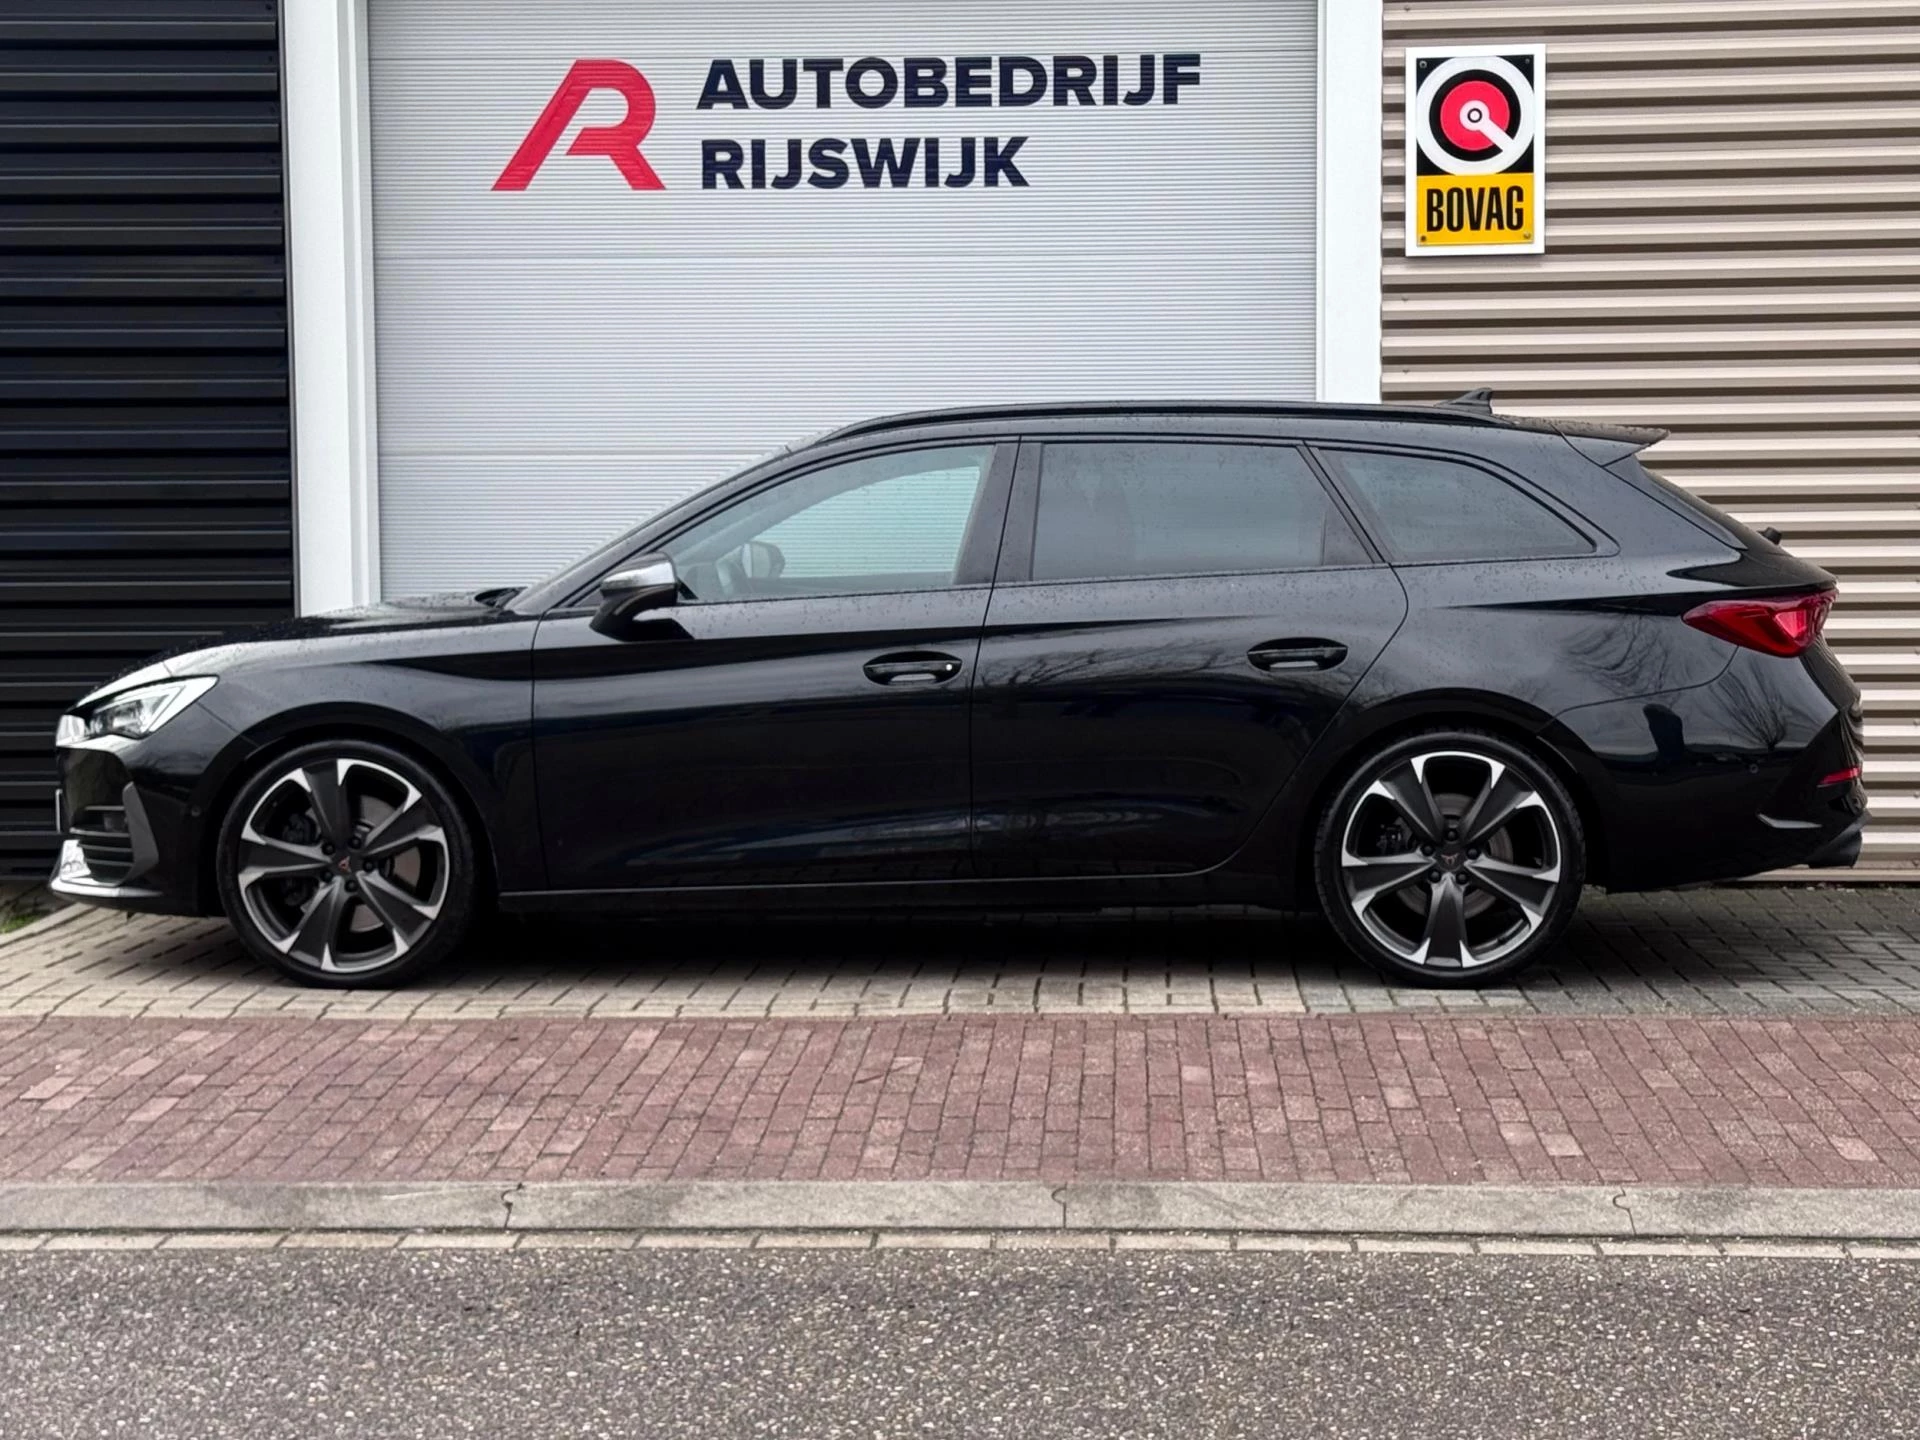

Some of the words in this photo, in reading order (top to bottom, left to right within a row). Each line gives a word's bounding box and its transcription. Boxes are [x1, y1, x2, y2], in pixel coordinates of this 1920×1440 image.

[696, 53, 1201, 110] AUTOBEDRIJF
[701, 137, 1030, 190] RIJSWIJK
[1426, 185, 1524, 233] BOVAG
